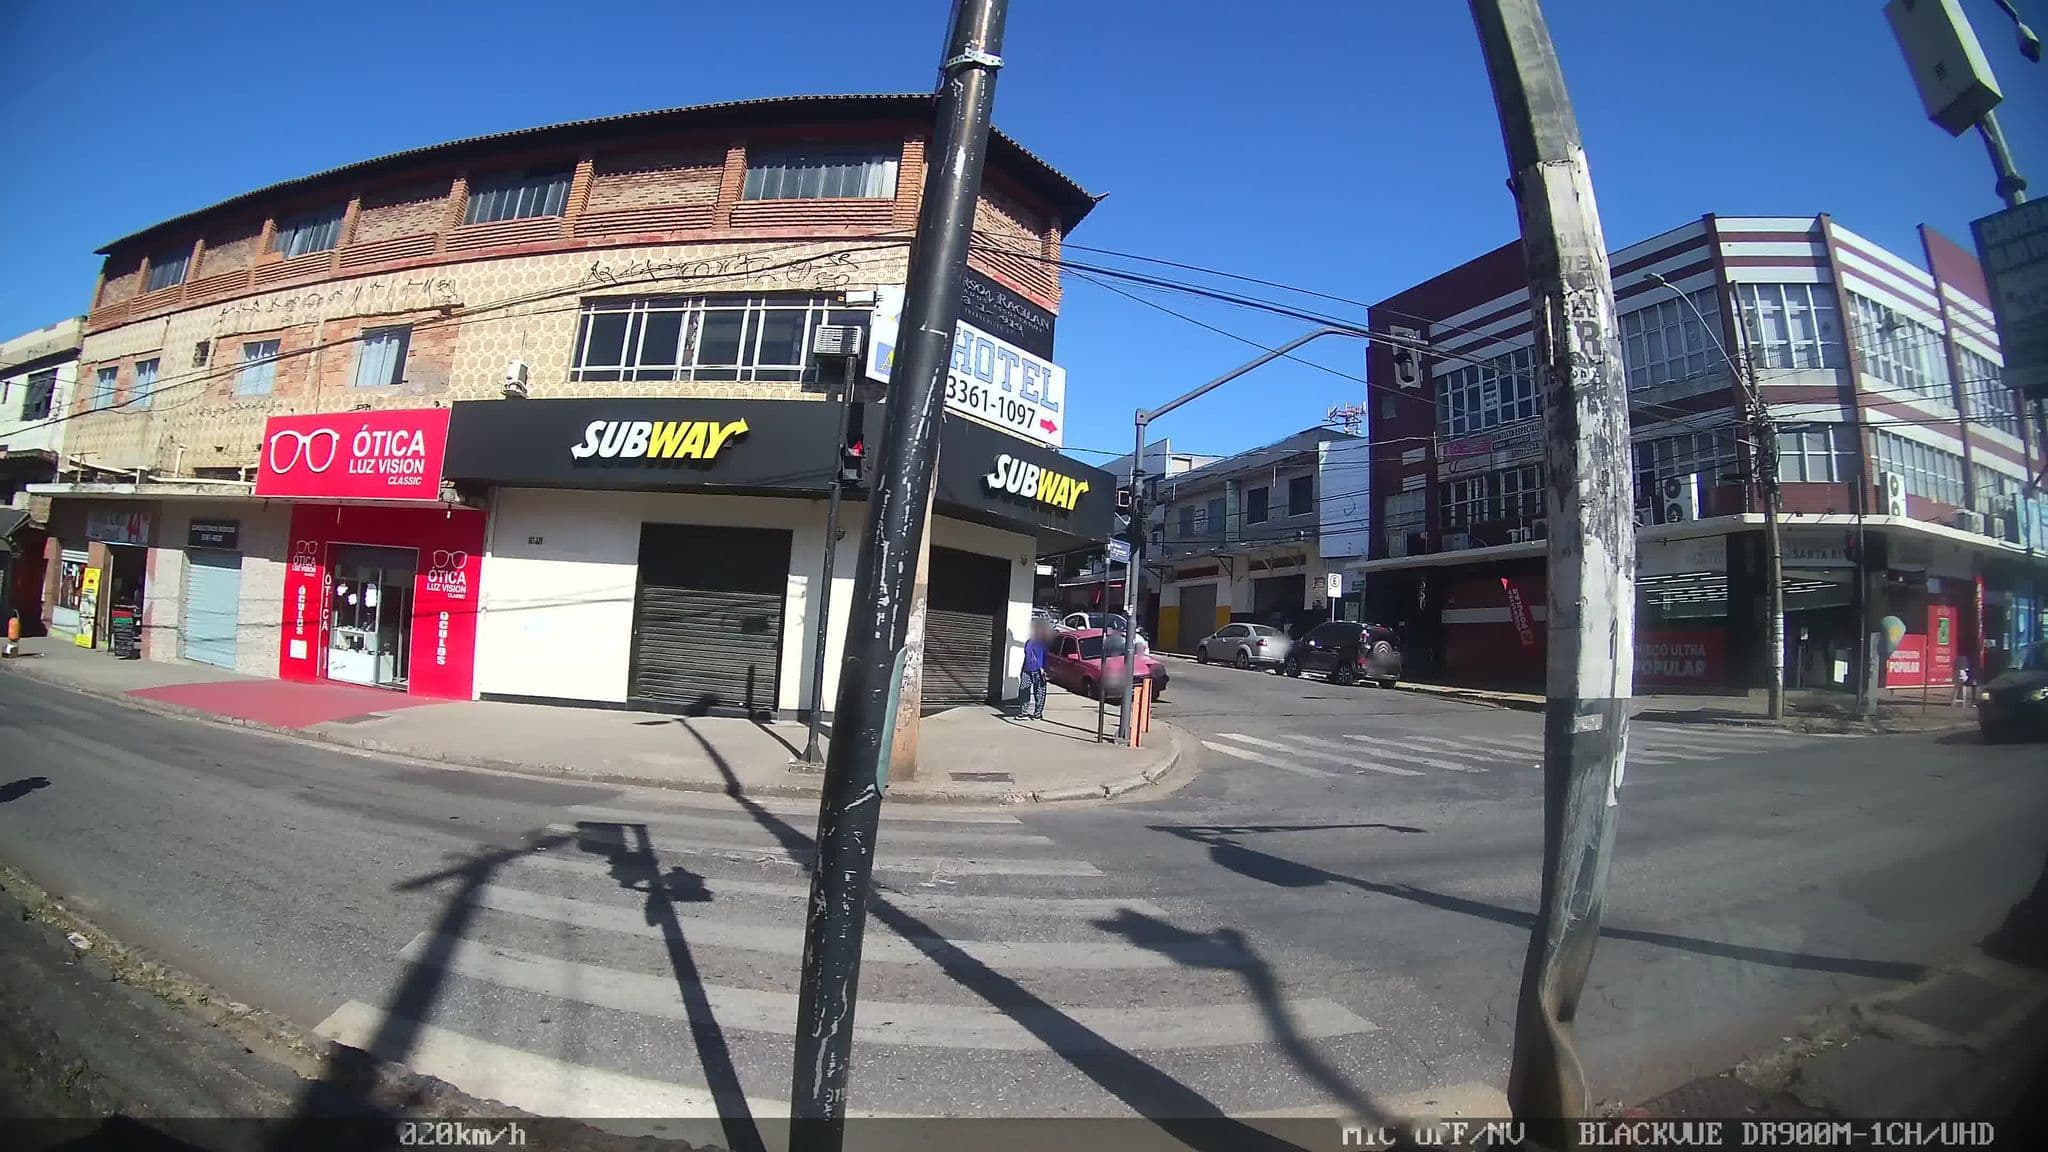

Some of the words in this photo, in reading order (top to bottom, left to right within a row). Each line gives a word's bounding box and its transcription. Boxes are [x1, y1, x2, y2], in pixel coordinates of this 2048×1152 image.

[950, 326, 1059, 413] HOTEL
[946, 375, 1036, 429] 3361-1097
[352, 424, 426, 457] ÓTICA
[570, 417, 750, 460] SUBWAY
[349, 459, 375, 474] LUZ
[378, 459, 425, 474] VISION
[387, 476, 422, 486] CLASSIC
[986, 453, 1091, 512] SUBWAY
[428, 566, 467, 586] ÓTICA
[426, 583, 441, 592] LUZ
[442, 584, 467, 594] VISION
[1671, 643, 1706, 657] ULTRA
[1889, 661, 1921, 674] POPULAR
